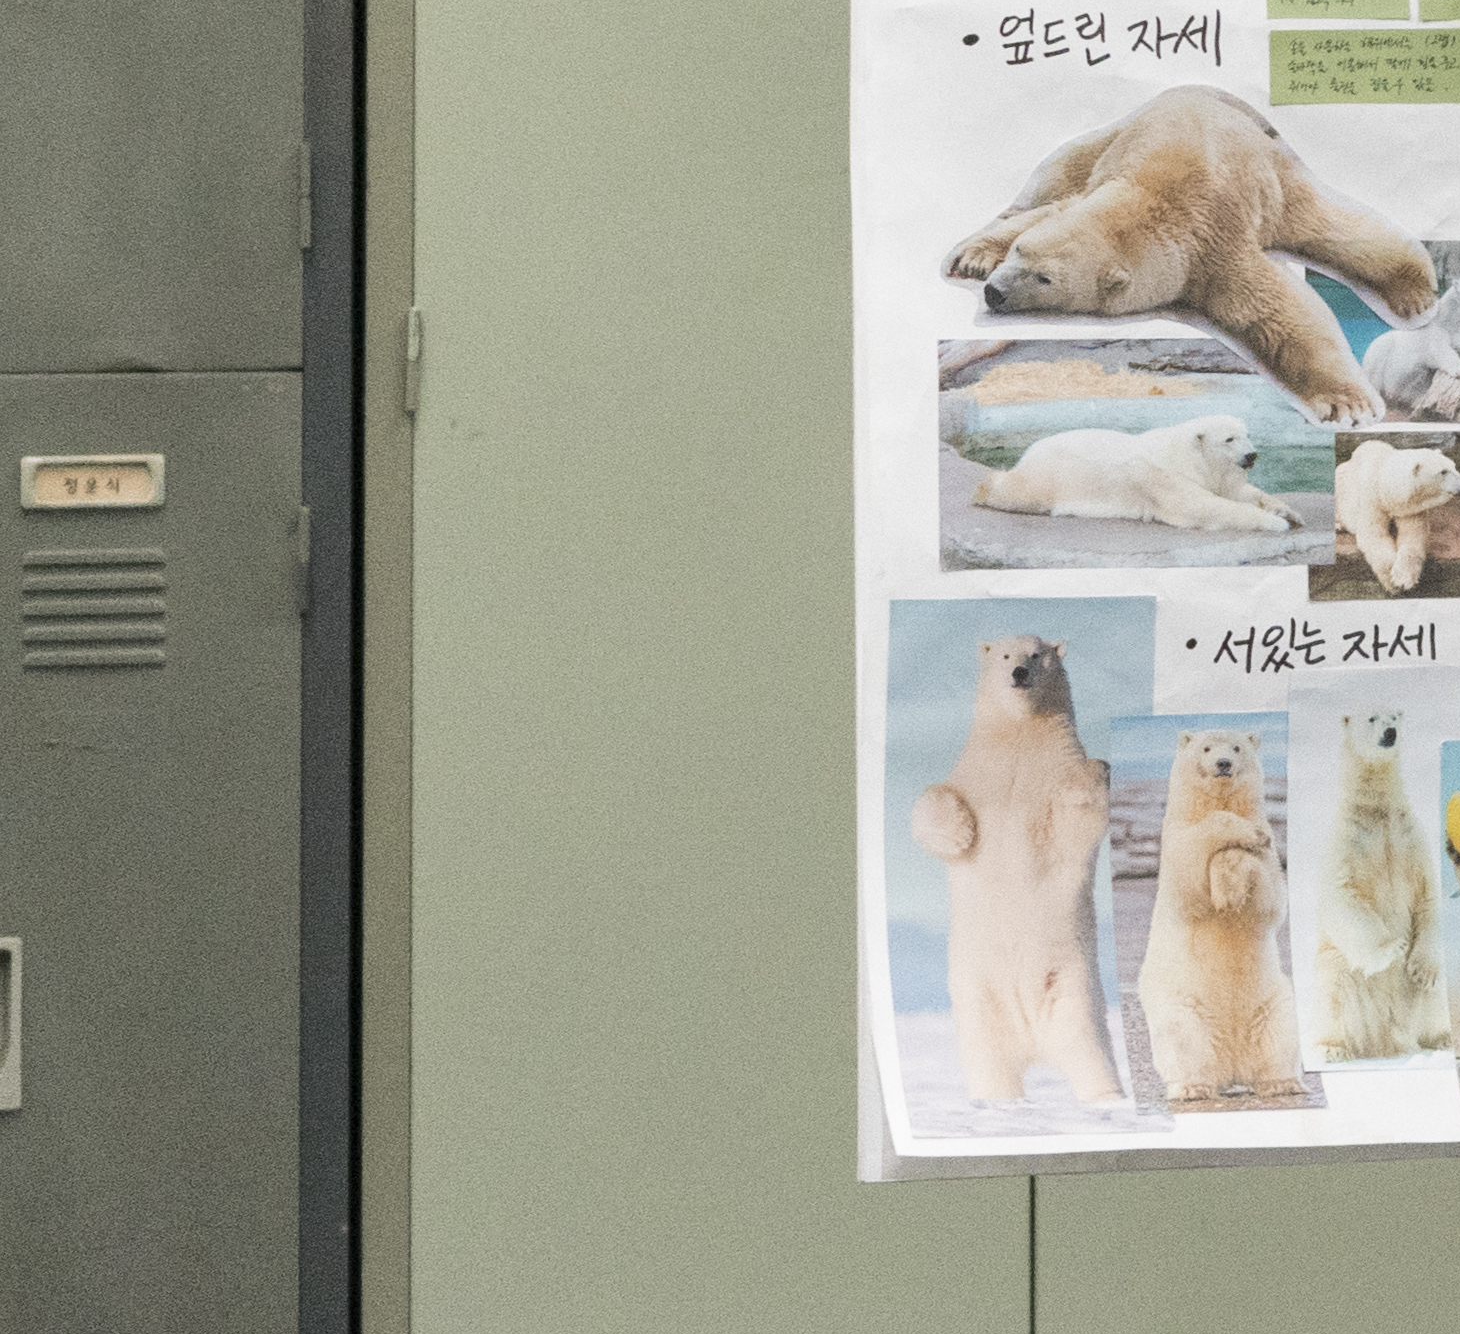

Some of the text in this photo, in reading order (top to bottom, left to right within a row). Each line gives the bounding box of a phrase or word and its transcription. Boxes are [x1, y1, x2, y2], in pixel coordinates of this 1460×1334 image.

[999, 7, 1223, 68] 엎드린 자세
[1212, 616, 1438, 675] 서있는 자세
